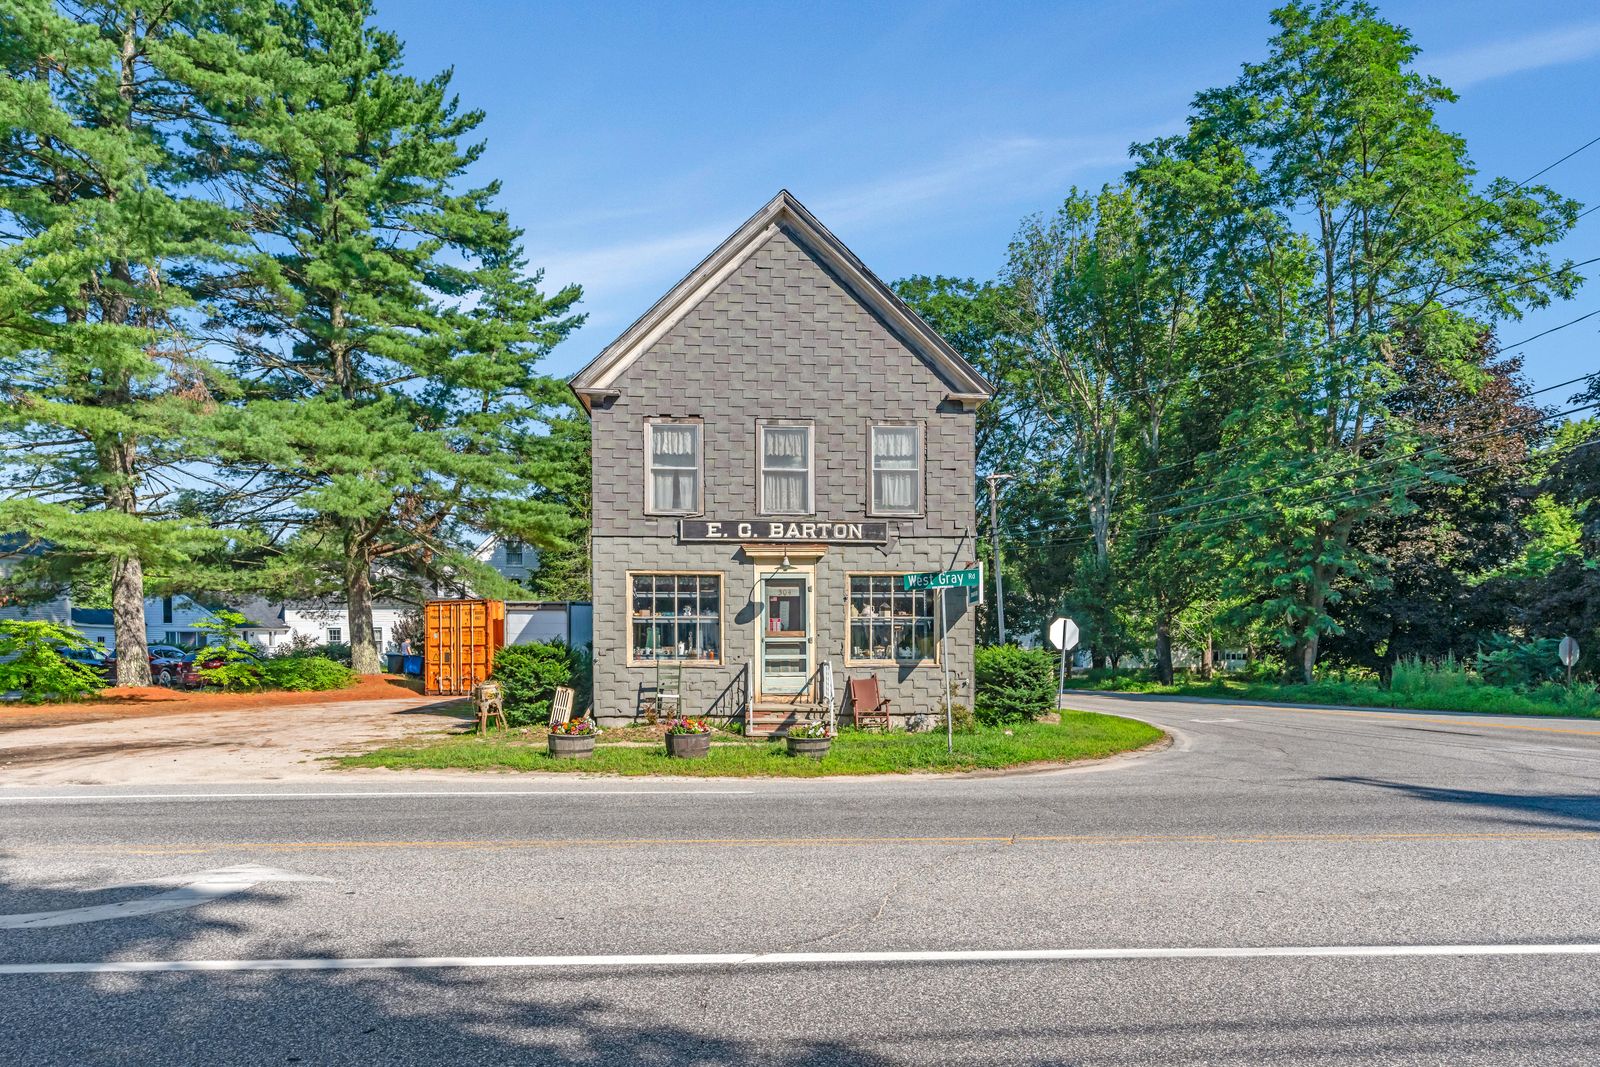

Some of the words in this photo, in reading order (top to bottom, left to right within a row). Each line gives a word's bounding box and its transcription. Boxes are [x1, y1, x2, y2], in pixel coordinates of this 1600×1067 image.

[705, 522, 728, 538] E.
[768, 522, 864, 539] BARTON
[907, 574, 934, 587] West
[938, 573, 964, 586] Gray
